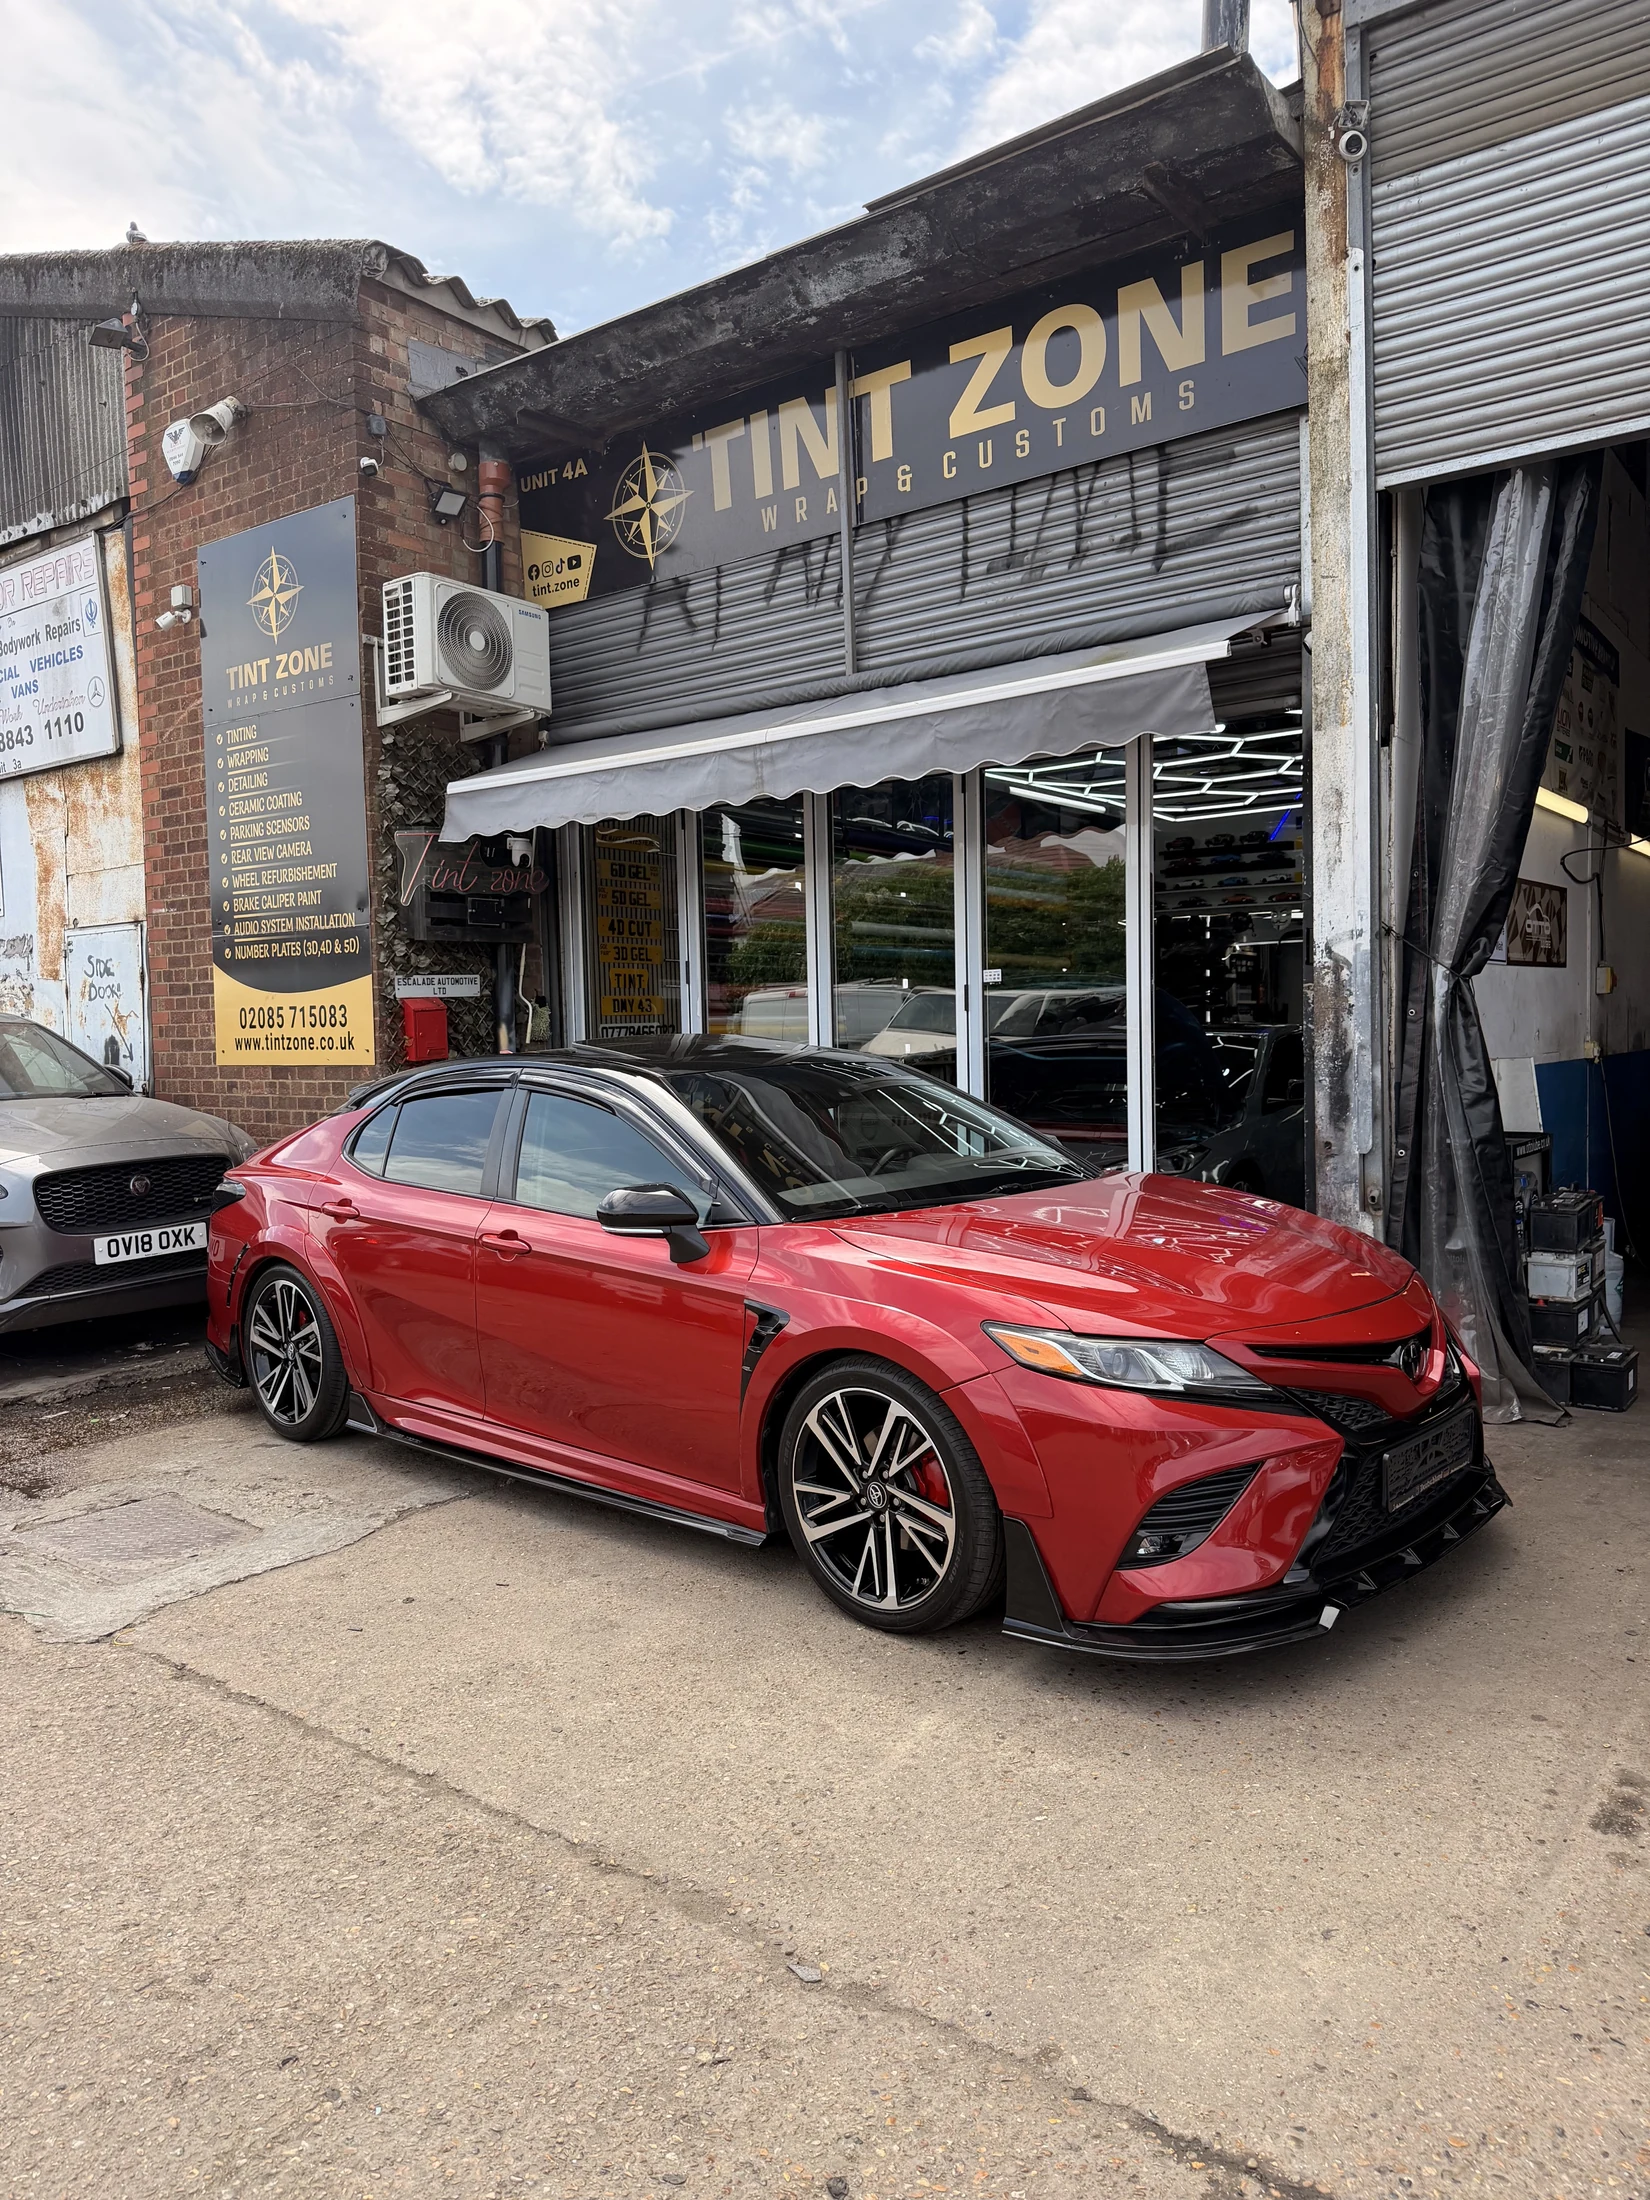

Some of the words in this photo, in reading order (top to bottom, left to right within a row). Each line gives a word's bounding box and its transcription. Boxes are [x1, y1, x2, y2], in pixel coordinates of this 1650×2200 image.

[692, 360, 911, 512] TINT
[949, 229, 1296, 439] ZONE
[761, 477, 868, 533] WRAP
[896, 464, 913, 492] &
[943, 379, 1195, 479] CUSTOMS
[520, 468, 558, 493] UNIT
[562, 458, 588, 480] 4A
[20, 547, 95, 601] REPAIRS
[532, 577, 580, 597] tint.zone
[518, 609, 542, 620] SAMSUNG
[45, 616, 81, 643] Repairs
[30, 645, 84, 673] VEHICLES
[226, 658, 270, 692] TINT
[276, 642, 333, 679] ZONE
[11, 679, 39, 699] VANS
[227, 693, 257, 709] WRAP
[273, 674, 334, 698] CUSTOMS
[44, 711, 84, 740] 1110
[226, 724, 257, 744] TINTING
[13, 758, 22, 770] 3a
[227, 747, 269, 769] WRAPPING
[228, 772, 268, 793] DETAILING
[229, 797, 265, 816] CERAMIC
[266, 791, 303, 810] COATING
[230, 822, 264, 840] PARKING
[266, 815, 310, 835] SCENSORS
[231, 848, 252, 864] REAR
[254, 846, 275, 861] VIEW
[276, 840, 313, 859] CAMERA
[232, 871, 260, 889] WHEEL
[261, 863, 338, 885] REFURBISHEMENT
[396, 833, 482, 903] Tint
[490, 868, 549, 893] zone
[611, 863, 626, 878] 6D
[629, 864, 651, 881] GEL
[233, 896, 260, 912] BRAKE
[261, 893, 296, 909] CALIPER
[297, 890, 322, 906] PAINT
[612, 889, 626, 905] 5D
[629, 891, 651, 907] GEL
[234, 920, 259, 935] AUDIO
[261, 917, 293, 935] SYSTEM
[295, 912, 356, 932] INSTALLATION
[608, 918, 625, 936] 4D
[629, 920, 652, 937] CUT
[235, 943, 269, 960] NUMBER
[271, 941, 301, 957] PLATES
[303, 938, 332, 957] (3D,4D
[334, 938, 342, 954] &
[343, 935, 360, 955] 5D)
[613, 946, 628, 960] 3D
[630, 946, 652, 961] GEL
[84, 954, 115, 978] SIDE
[397, 977, 436, 986] ESCALADE
[437, 977, 478, 985] AUTOMOTIVE
[433, 987, 447, 995] LTD
[615, 973, 643, 989] TINT
[239, 1006, 284, 1029] 02085
[289, 1004, 348, 1028] 715083
[638, 998, 652, 1012] 43
[235, 1031, 355, 1051] www.tintzone.co.uk
[107, 1233, 153, 1258] OV18
[158, 1227, 196, 1250] OXK
